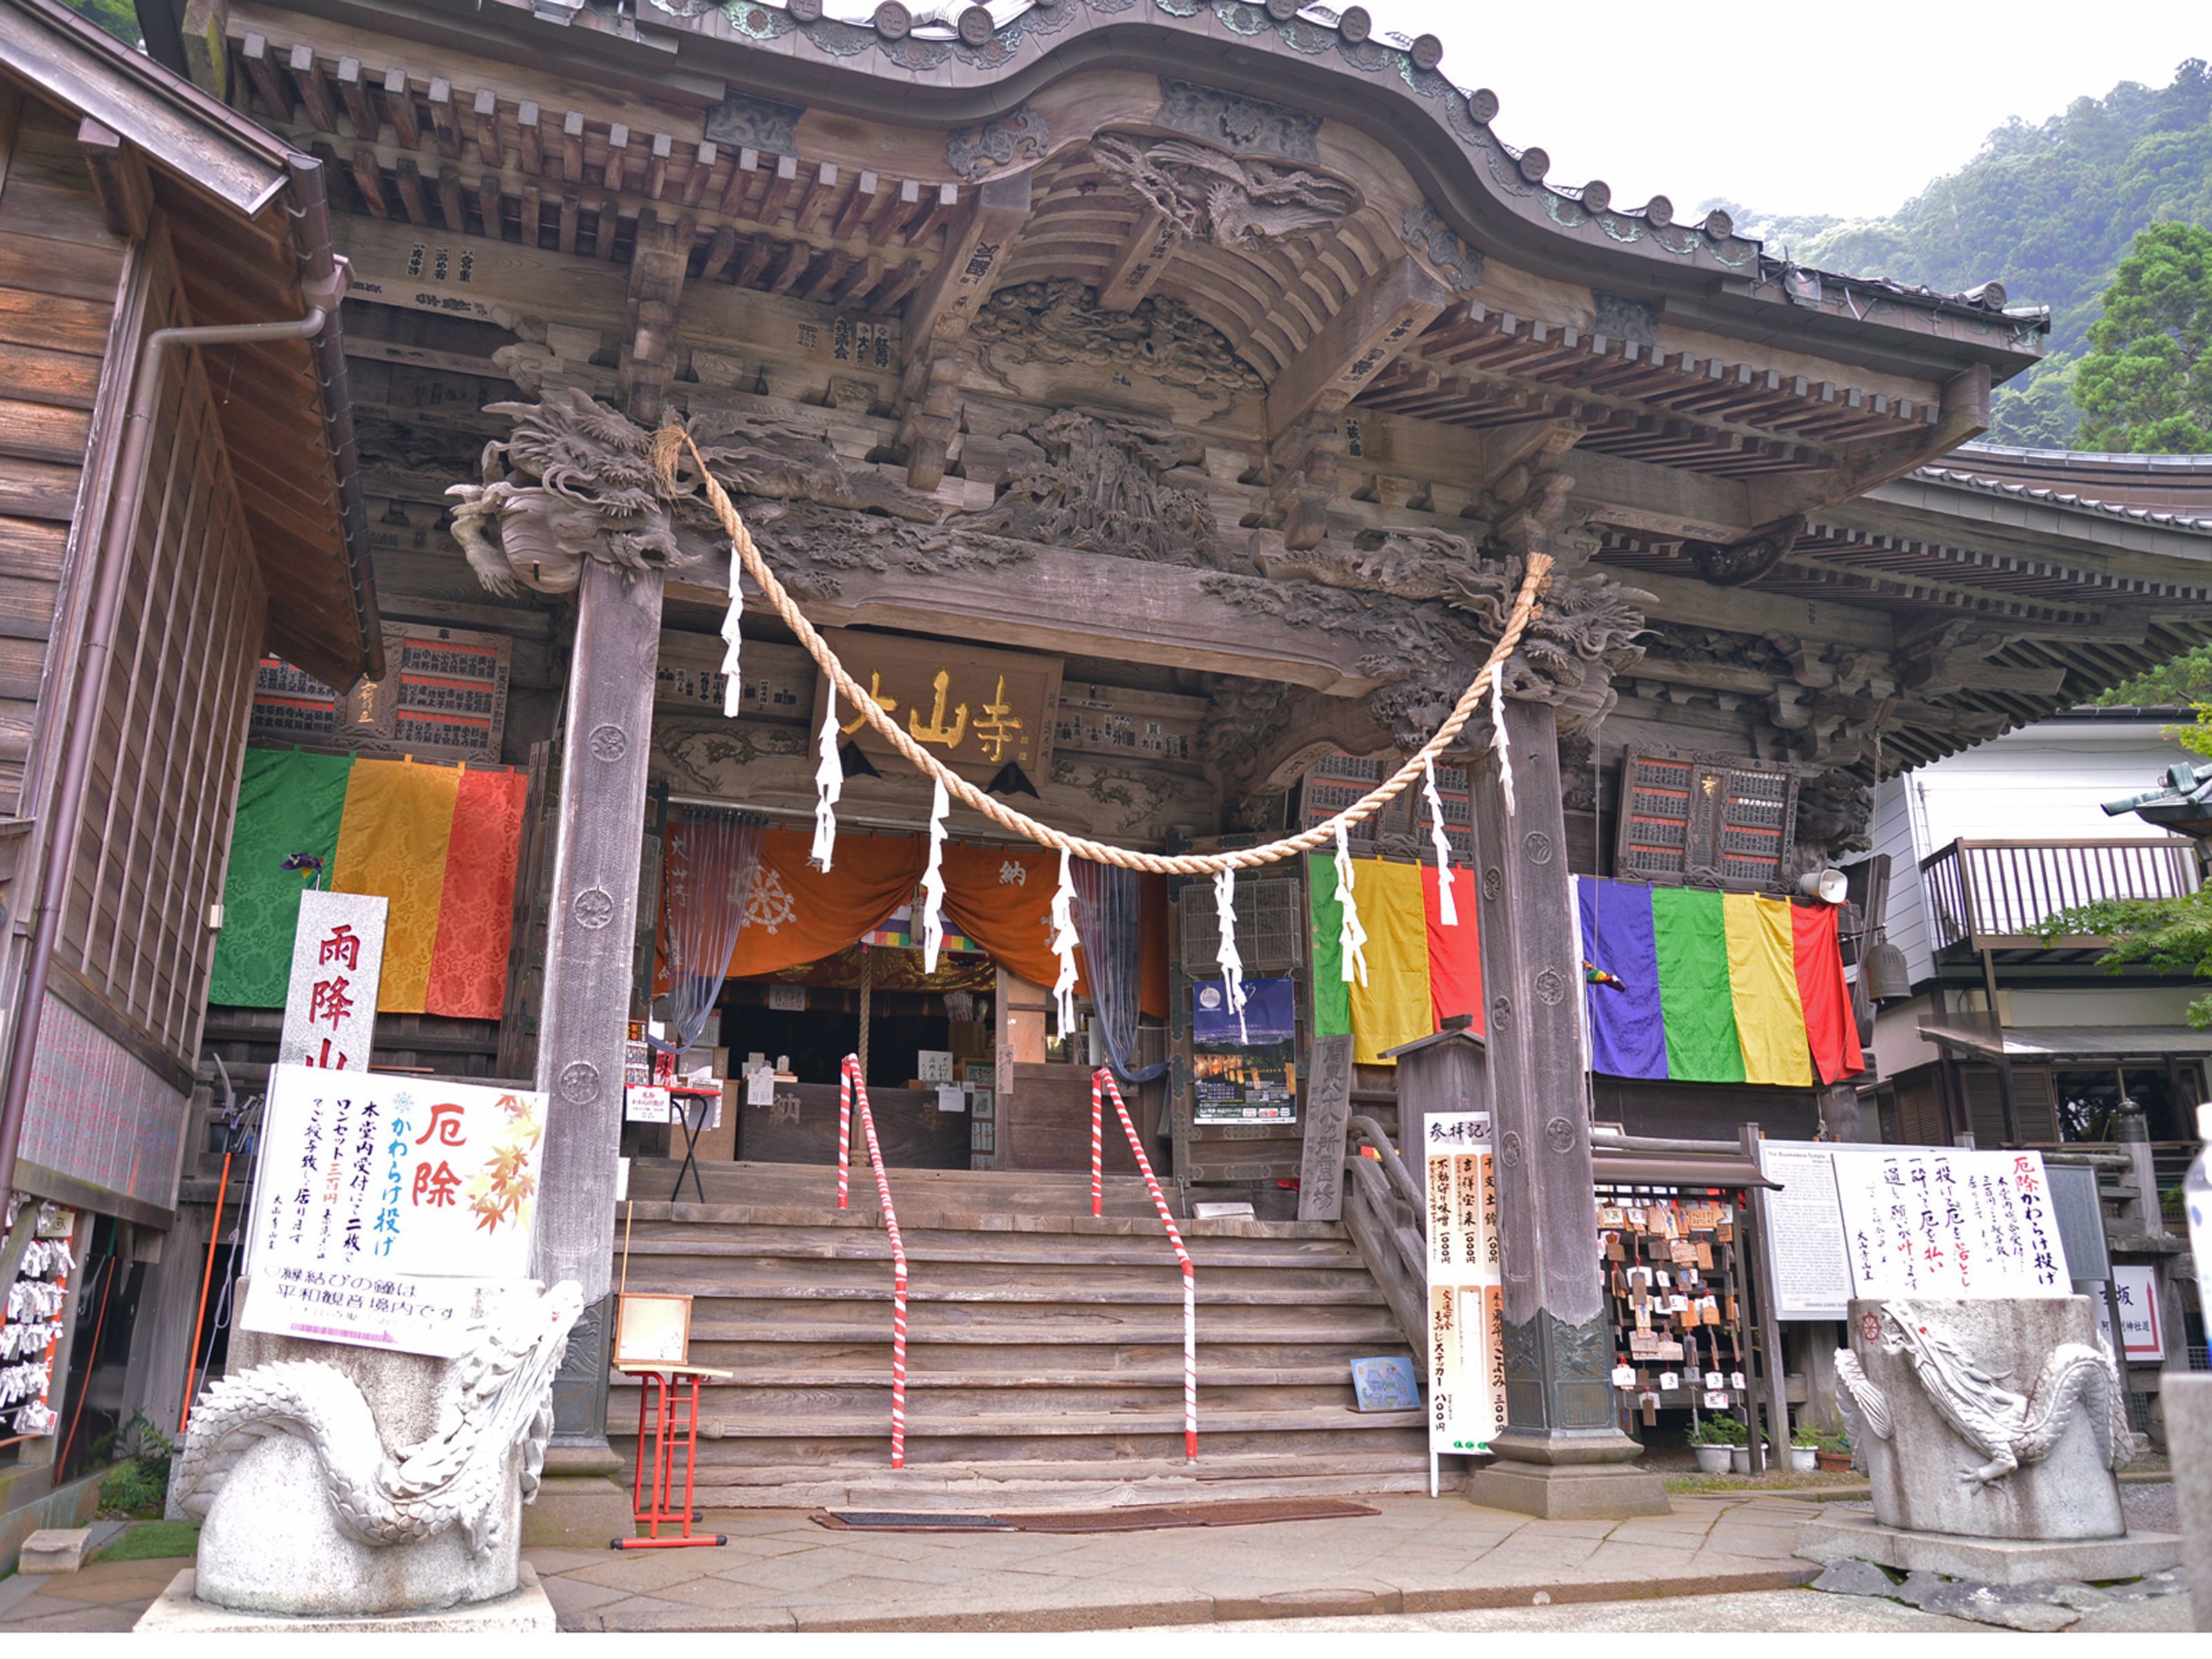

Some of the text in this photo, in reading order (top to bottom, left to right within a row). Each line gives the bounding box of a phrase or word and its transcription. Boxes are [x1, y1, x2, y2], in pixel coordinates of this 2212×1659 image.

[840, 666, 1023, 762] 大山寺
[999, 860, 1027, 886] 納
[306, 924, 361, 1071] 雨降山
[373, 1117, 412, 1257] かわらけ投げ
[413, 1103, 468, 1208] 厄除
[2013, 1156, 2059, 1285] 厄除かわらけ投げ
[275, 1283, 453, 1320] 平和観音境内です
